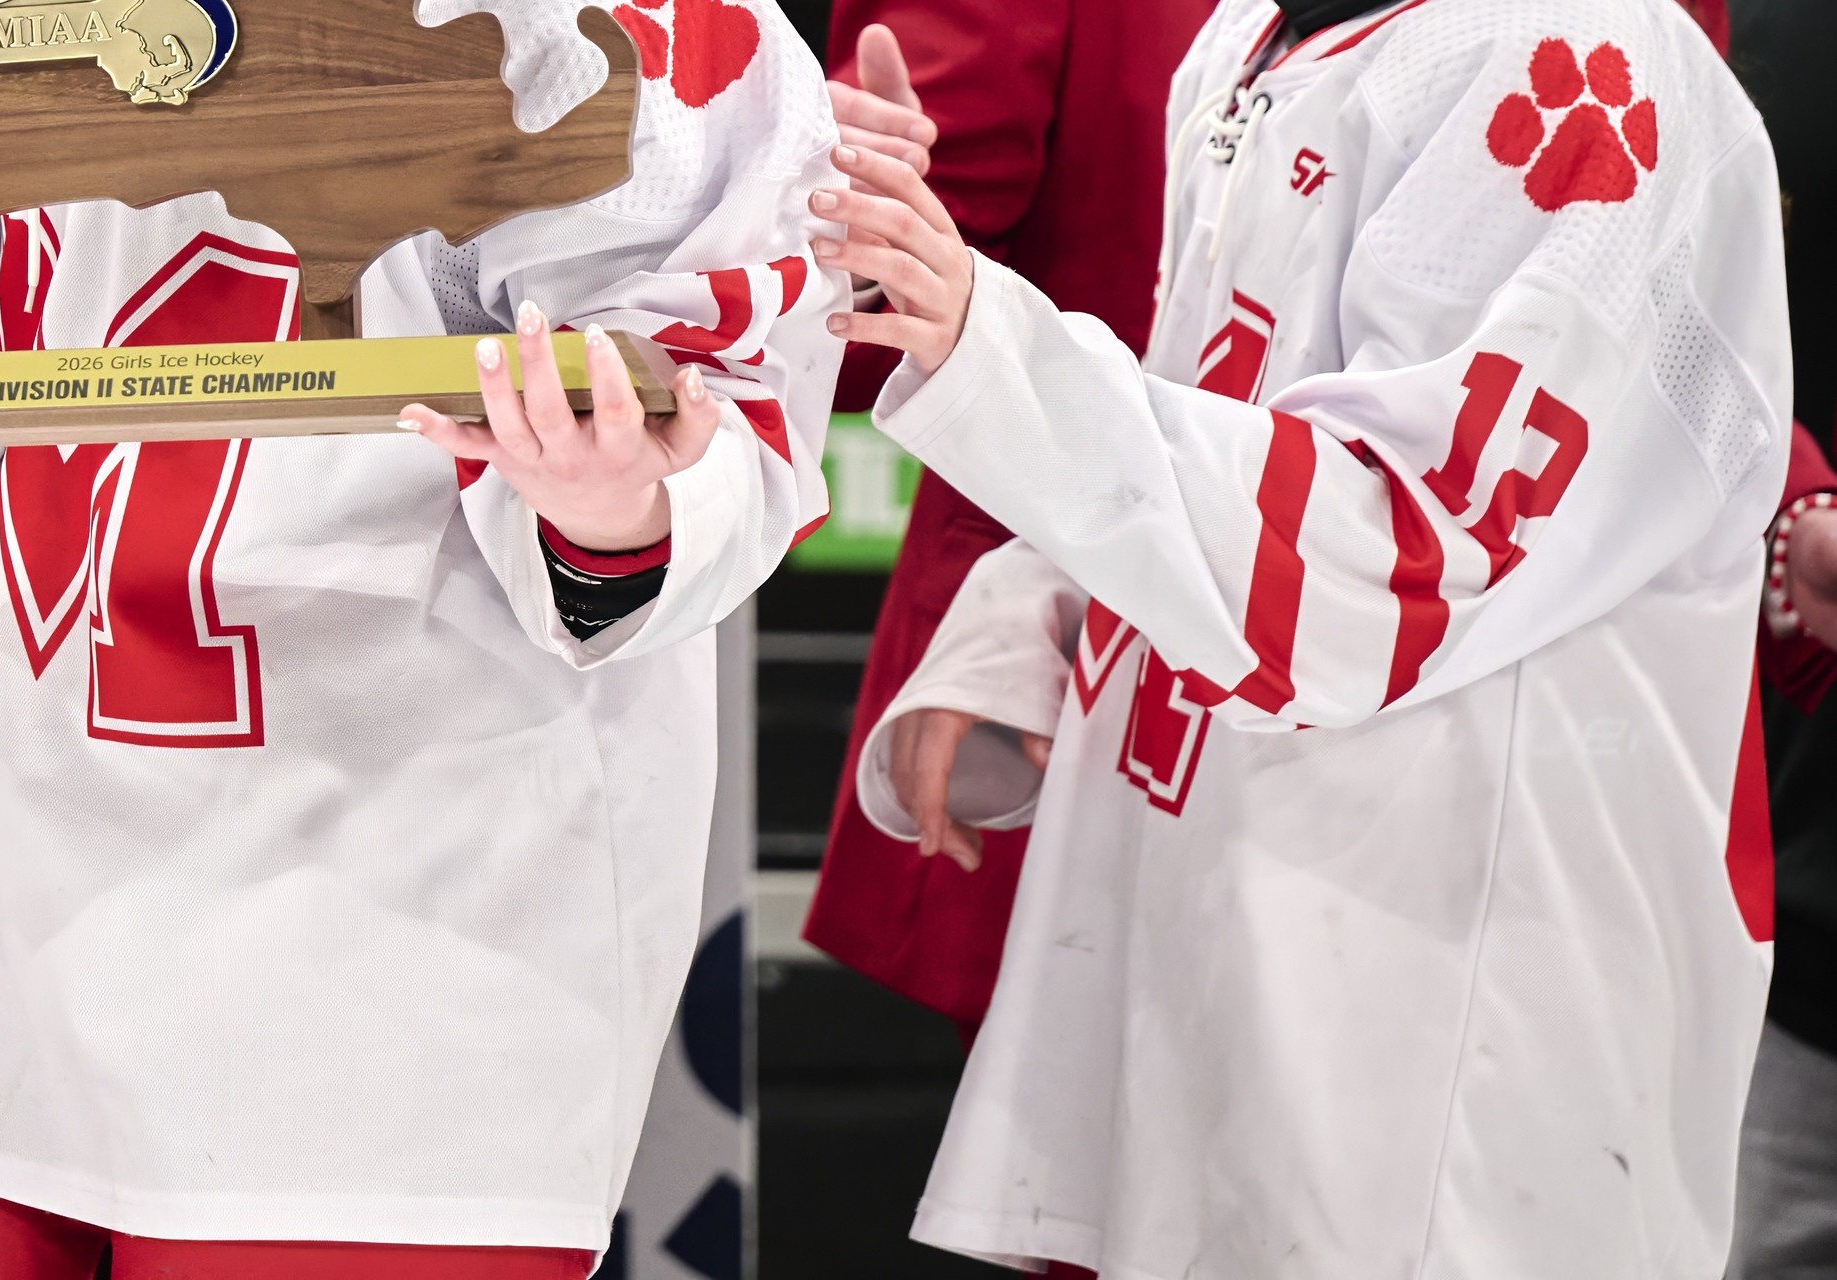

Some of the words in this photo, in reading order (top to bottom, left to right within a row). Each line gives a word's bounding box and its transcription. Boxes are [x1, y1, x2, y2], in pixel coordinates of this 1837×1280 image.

[57, 356, 103, 371] 2026
[111, 353, 152, 369] Girls
[160, 353, 188, 368] Ice
[195, 352, 264, 369] Hockey
[97, 377, 112, 398] II
[121, 375, 193, 397] STATE
[202, 370, 336, 395] CHAMPION
